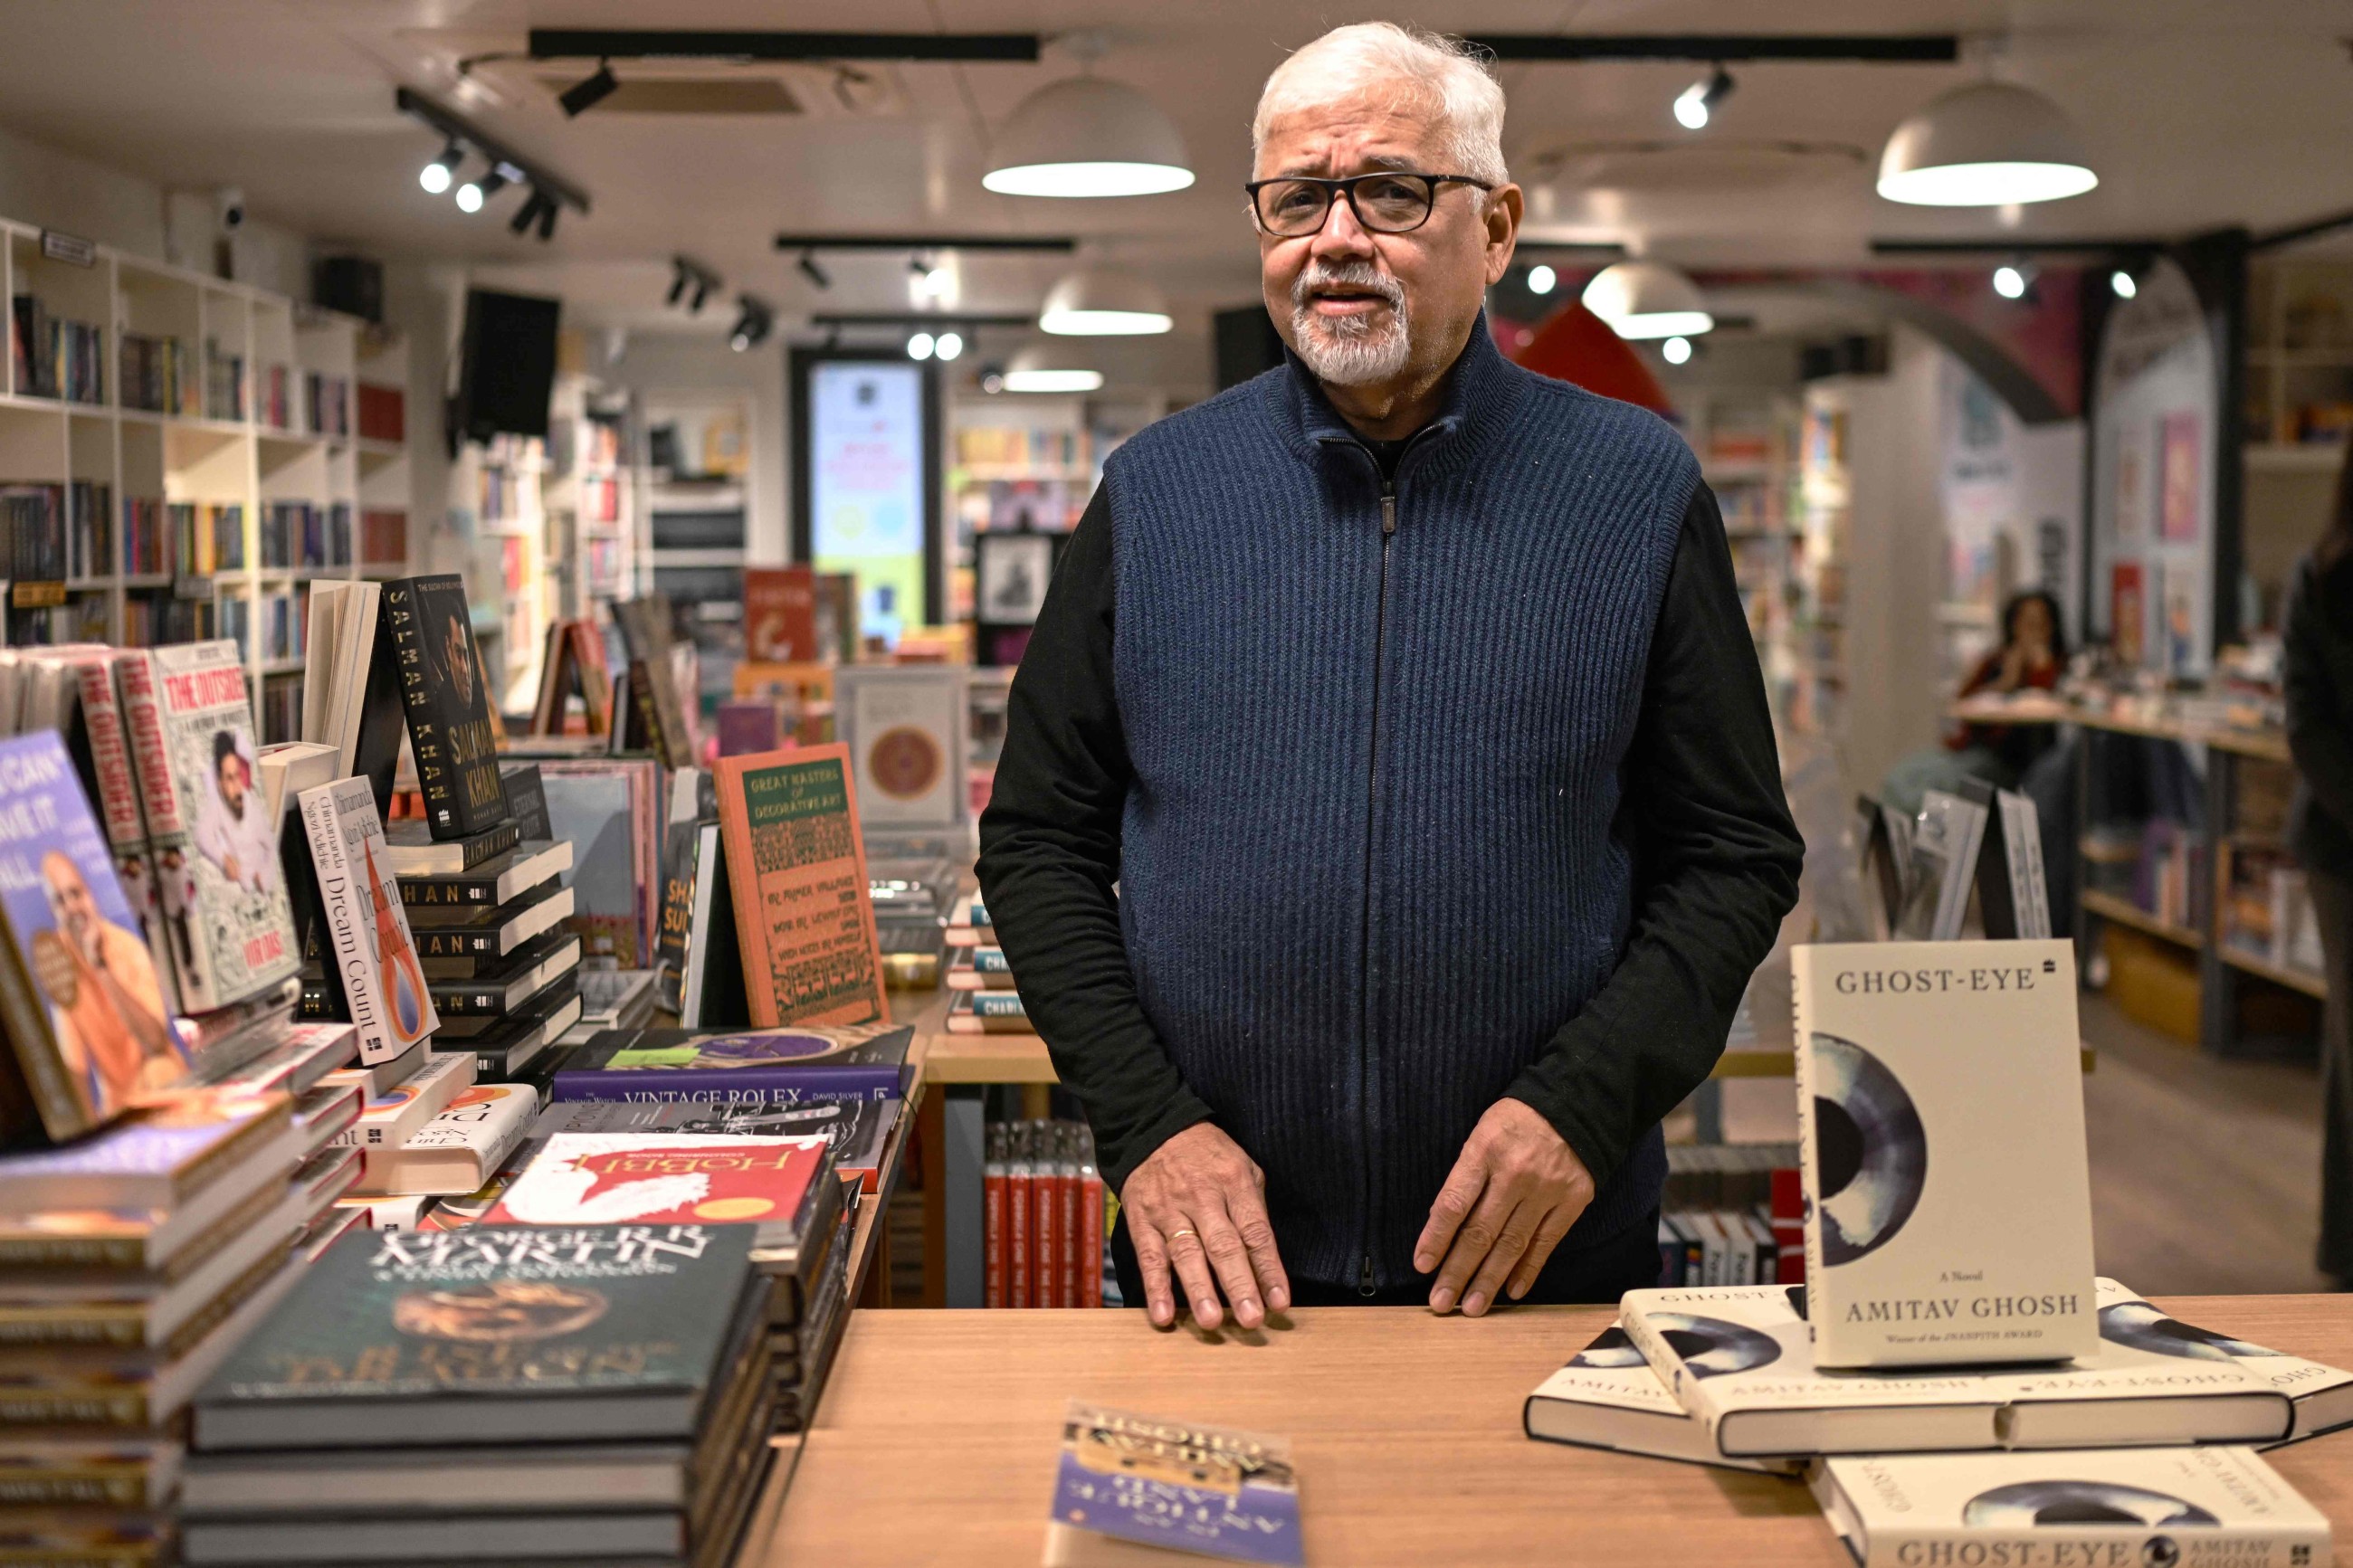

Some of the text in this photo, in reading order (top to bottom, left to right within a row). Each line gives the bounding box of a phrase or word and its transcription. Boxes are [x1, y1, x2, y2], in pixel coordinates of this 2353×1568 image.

[164, 673, 198, 713] THE
[390, 590, 430, 707] SALMAN
[417, 725, 449, 801] KHAN
[449, 717, 497, 765] SALMAN
[464, 762, 500, 809] KHAN
[750, 767, 840, 794] GREAT MASTERS
[335, 782, 374, 816] Chimamanda
[755, 794, 843, 820] DECORATIVE ART
[305, 801, 329, 870] Ngozi Adichie
[319, 796, 346, 870] Chimamanda
[356, 878, 399, 922] Dream
[405, 885, 459, 903] HAN
[326, 876, 376, 1031] Dream Count
[369, 917, 409, 965] Count
[1836, 968, 2035, 995] GHOST-EYE
[624, 1088, 802, 1104] VINTAGE ROLEX
[813, 1090, 863, 1101] DAVID SILVER
[570, 1150, 793, 1174] HOBBIT
[1940, 1269, 1984, 1283] A Novel
[1660, 1290, 1779, 1304] GHOST-
[1845, 1294, 2079, 1323] AMITAV GHOSH
[2003, 1328, 2043, 1340] AWARD
[1897, 1539, 2131, 1567] GHOST-EYE
[2189, 1539, 2273, 1555] AMITAV
